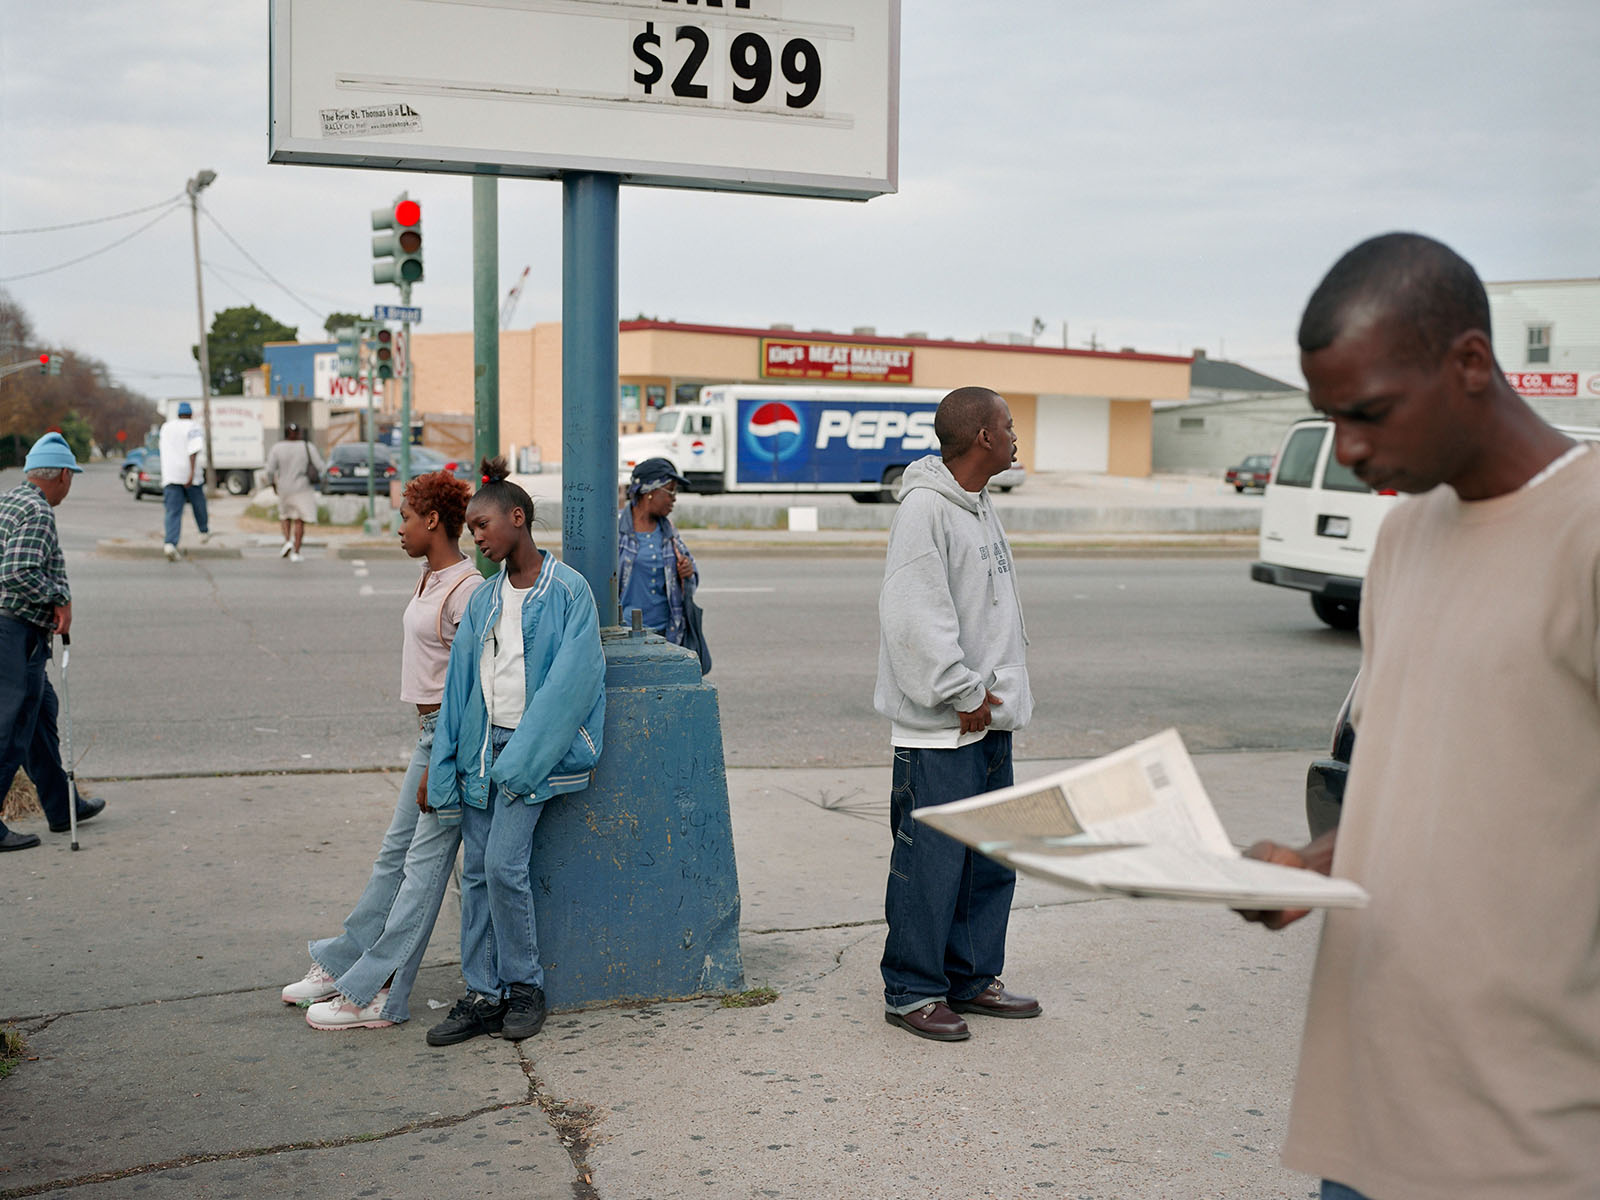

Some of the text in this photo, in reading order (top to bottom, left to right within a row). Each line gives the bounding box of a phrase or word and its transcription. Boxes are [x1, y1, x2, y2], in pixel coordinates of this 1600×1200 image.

[322, 113, 334, 121] The
[351, 109, 360, 120] St.
[361, 107, 387, 118] Thomas
[387, 107, 394, 117] is
[394, 108, 400, 116] a
[324, 122, 343, 131] RALLY
[808, 345, 849, 363] MEAT
[850, 347, 911, 368] MARKET
